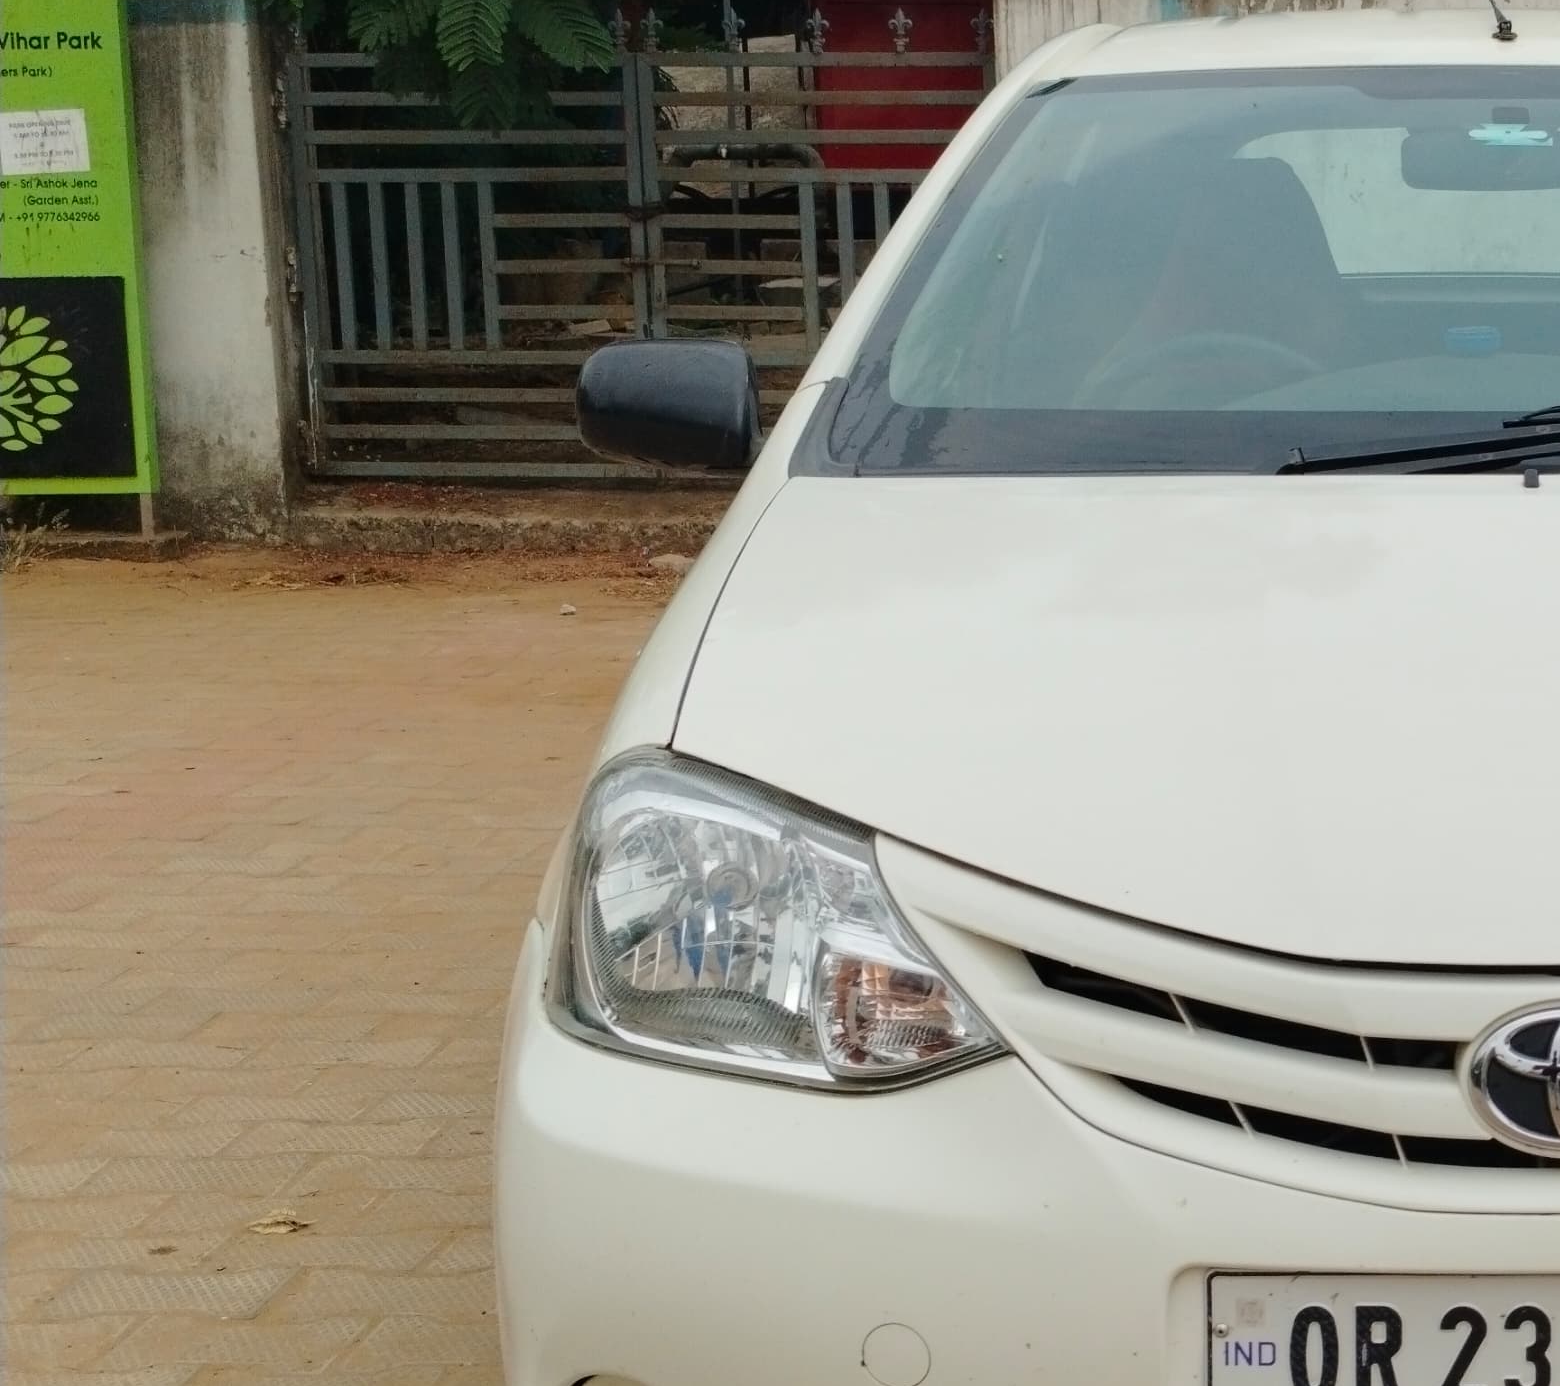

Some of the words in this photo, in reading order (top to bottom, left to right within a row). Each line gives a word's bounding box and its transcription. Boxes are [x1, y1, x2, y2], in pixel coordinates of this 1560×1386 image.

[0, 32, 50, 50] Vihar
[57, 31, 103, 50] Park
[22, 66, 53, 78] Park)
[36, 178, 67, 189] Ashok
[71, 177, 98, 189] Jena
[23, 195, 69, 206] (Garden
[71, 195, 99, 206] Asst.)
[1224, 1341, 1277, 1367] IND
